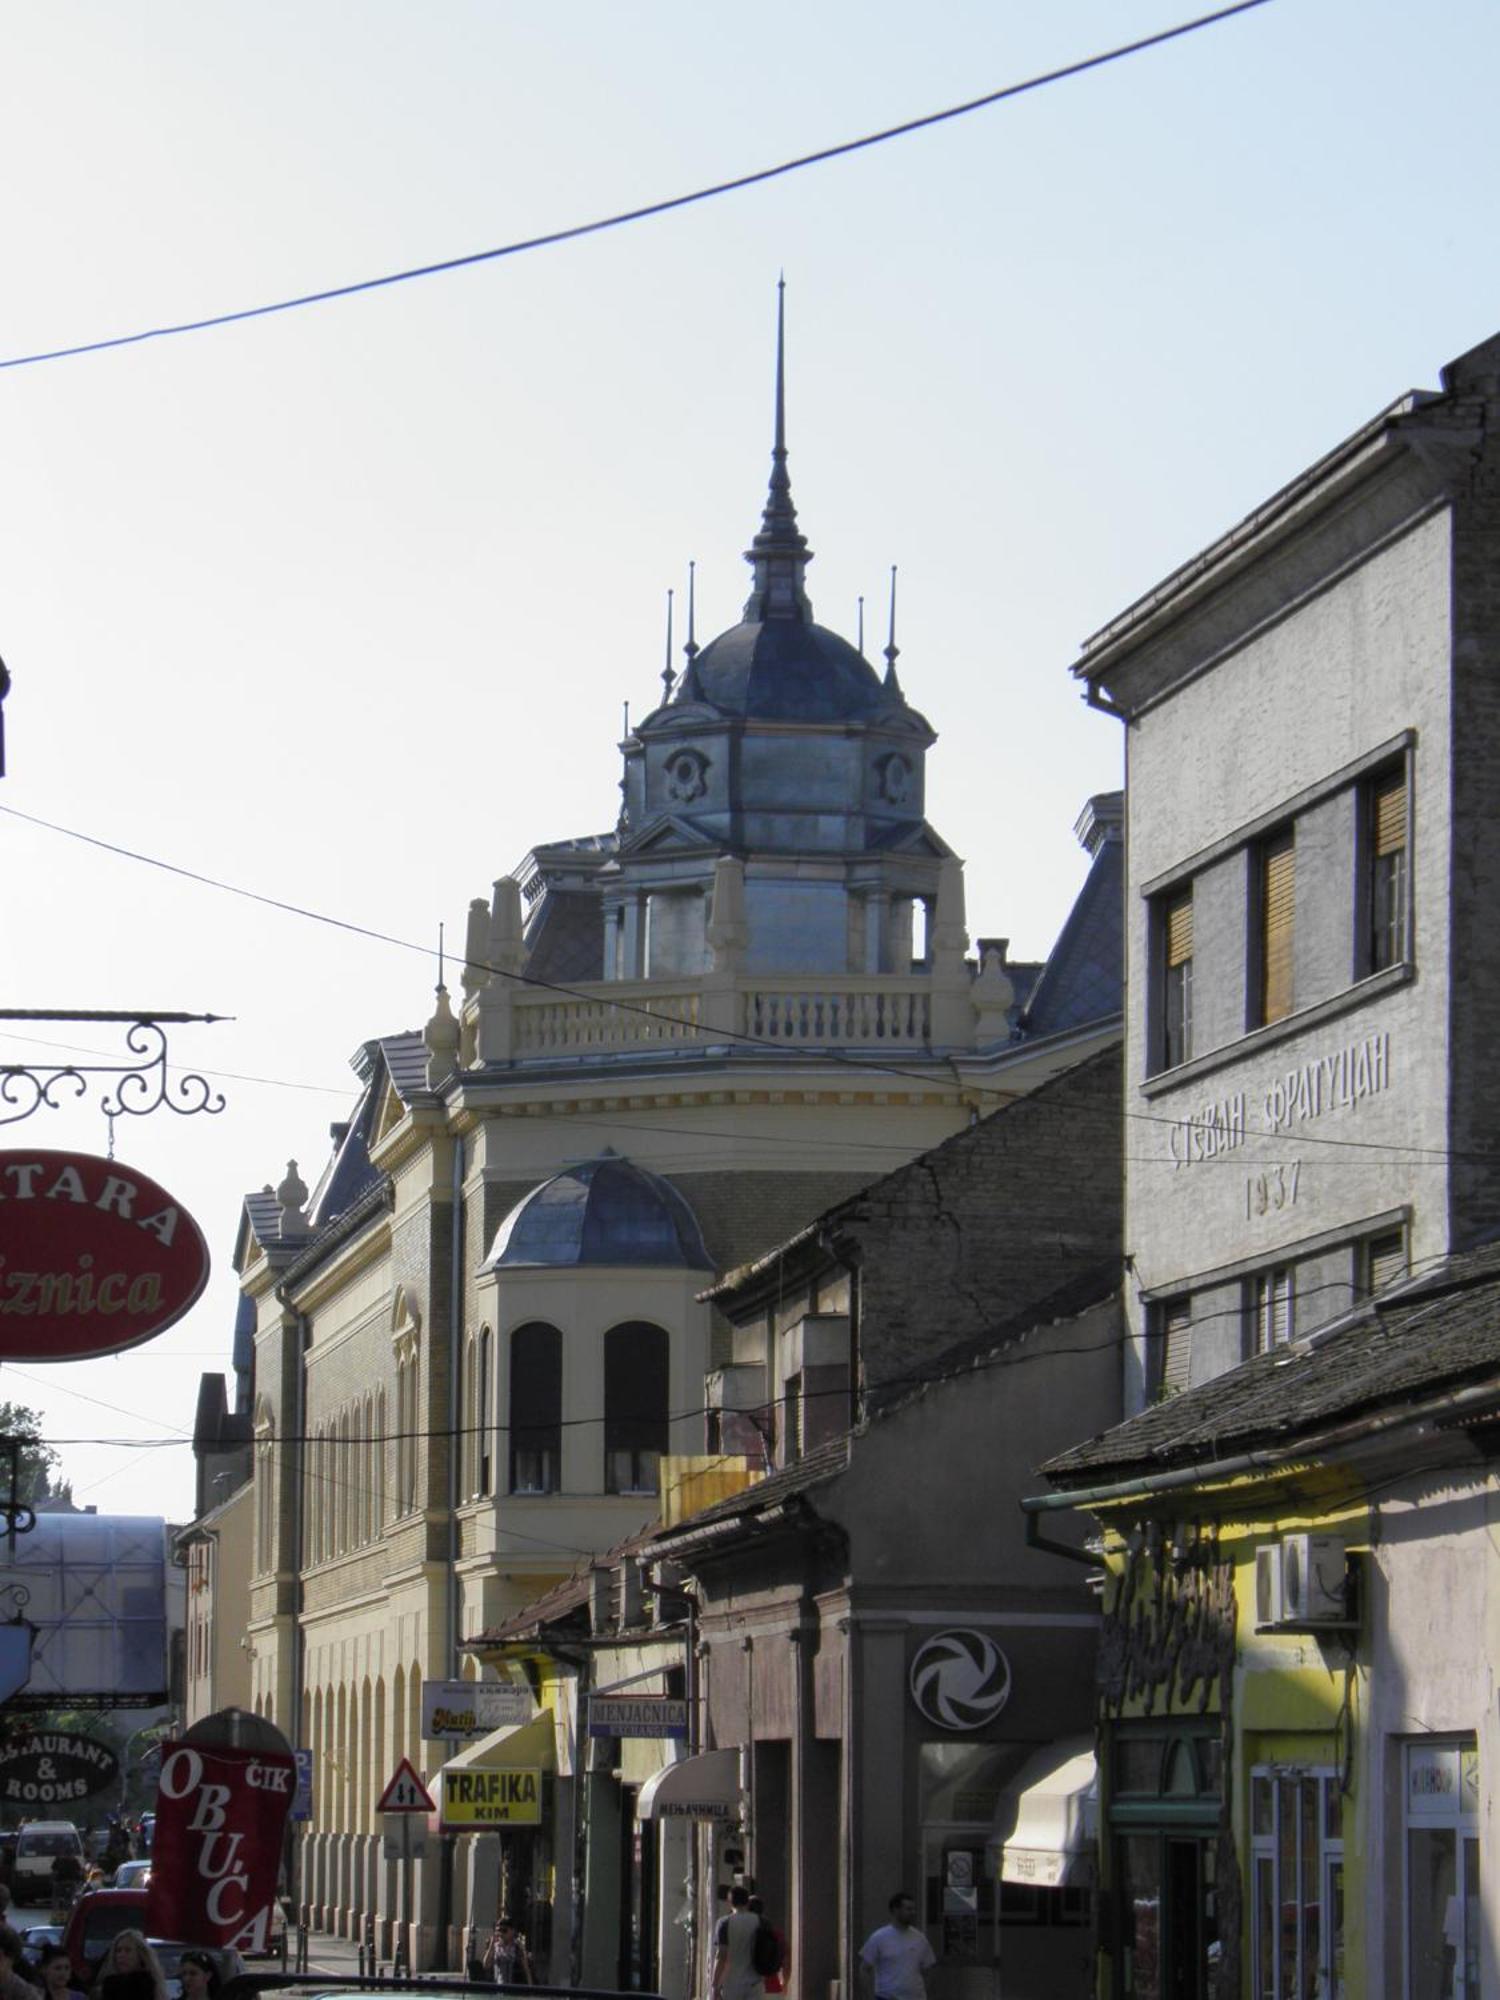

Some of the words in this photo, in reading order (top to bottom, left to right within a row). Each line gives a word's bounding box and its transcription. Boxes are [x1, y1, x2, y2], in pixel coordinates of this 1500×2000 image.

[1168, 1092, 1246, 1169] СТЕВАН
[1264, 1032, 1390, 1132] ФРАТУЦАН
[0, 1163, 179, 1247] TARA
[1246, 1159, 1301, 1221] 1937
[37, 1757, 57, 1780] &
[244, 1758, 291, 1793] ČIK
[5, 1778, 88, 1802] ROOMS
[446, 1773, 538, 1805] TRAFIKA
[474, 1806, 510, 1820] KIM
[160, 1748, 271, 1953] OBUĆA
